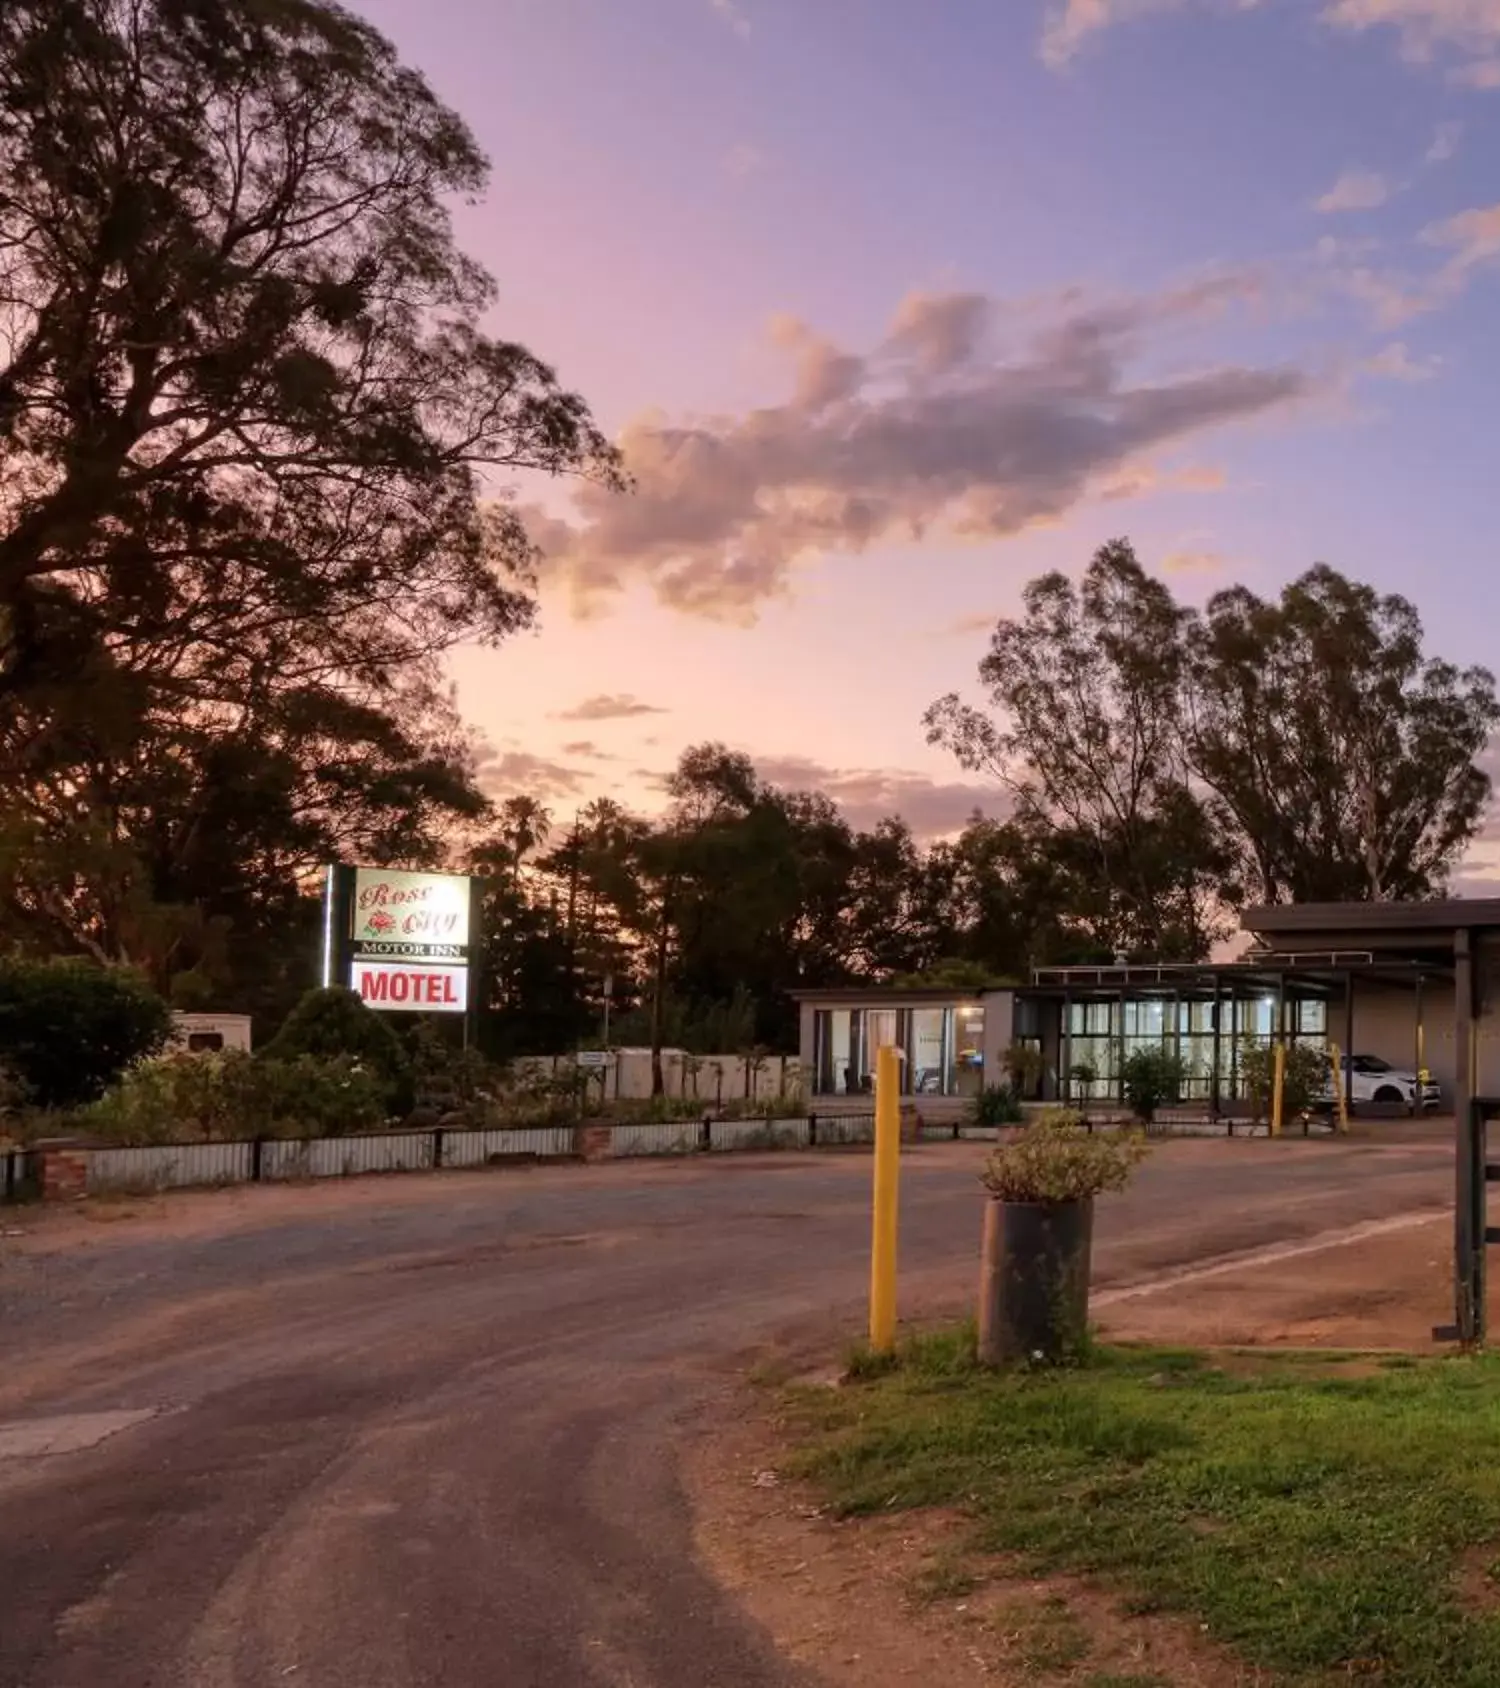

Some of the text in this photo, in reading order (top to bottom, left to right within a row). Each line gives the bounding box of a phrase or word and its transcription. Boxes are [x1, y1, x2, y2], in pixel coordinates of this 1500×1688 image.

[359, 883, 432, 909] Rose
[362, 943, 461, 957] MOTOR INN
[362, 972, 457, 1002] MOTEL
